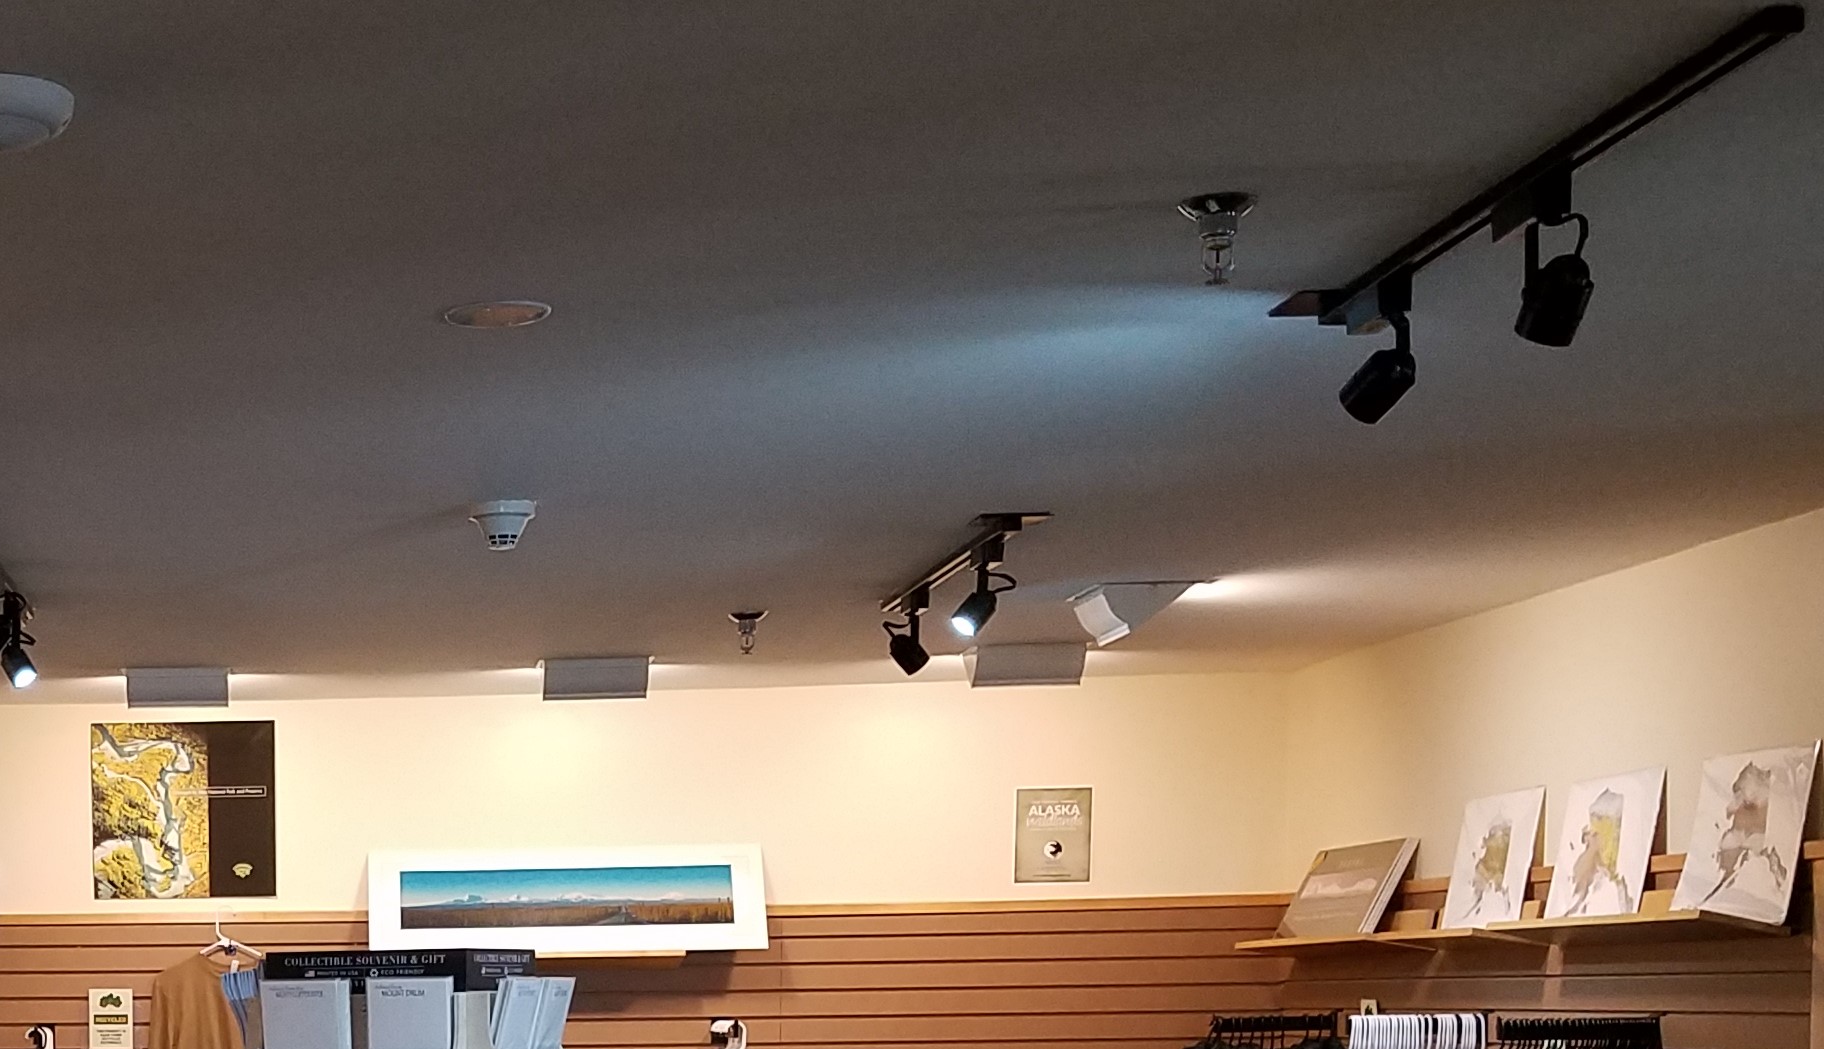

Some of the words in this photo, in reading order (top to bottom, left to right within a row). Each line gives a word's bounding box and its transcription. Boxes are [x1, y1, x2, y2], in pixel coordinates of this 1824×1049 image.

[1028, 804, 1081, 817] ALASKA
[284, 956, 354, 967] COLLECTIBLE
[356, 955, 408, 966] SOUVENIR
[410, 955, 419, 965] &
[421, 954, 446, 965] GIFT
[380, 969, 395, 977] ECO
